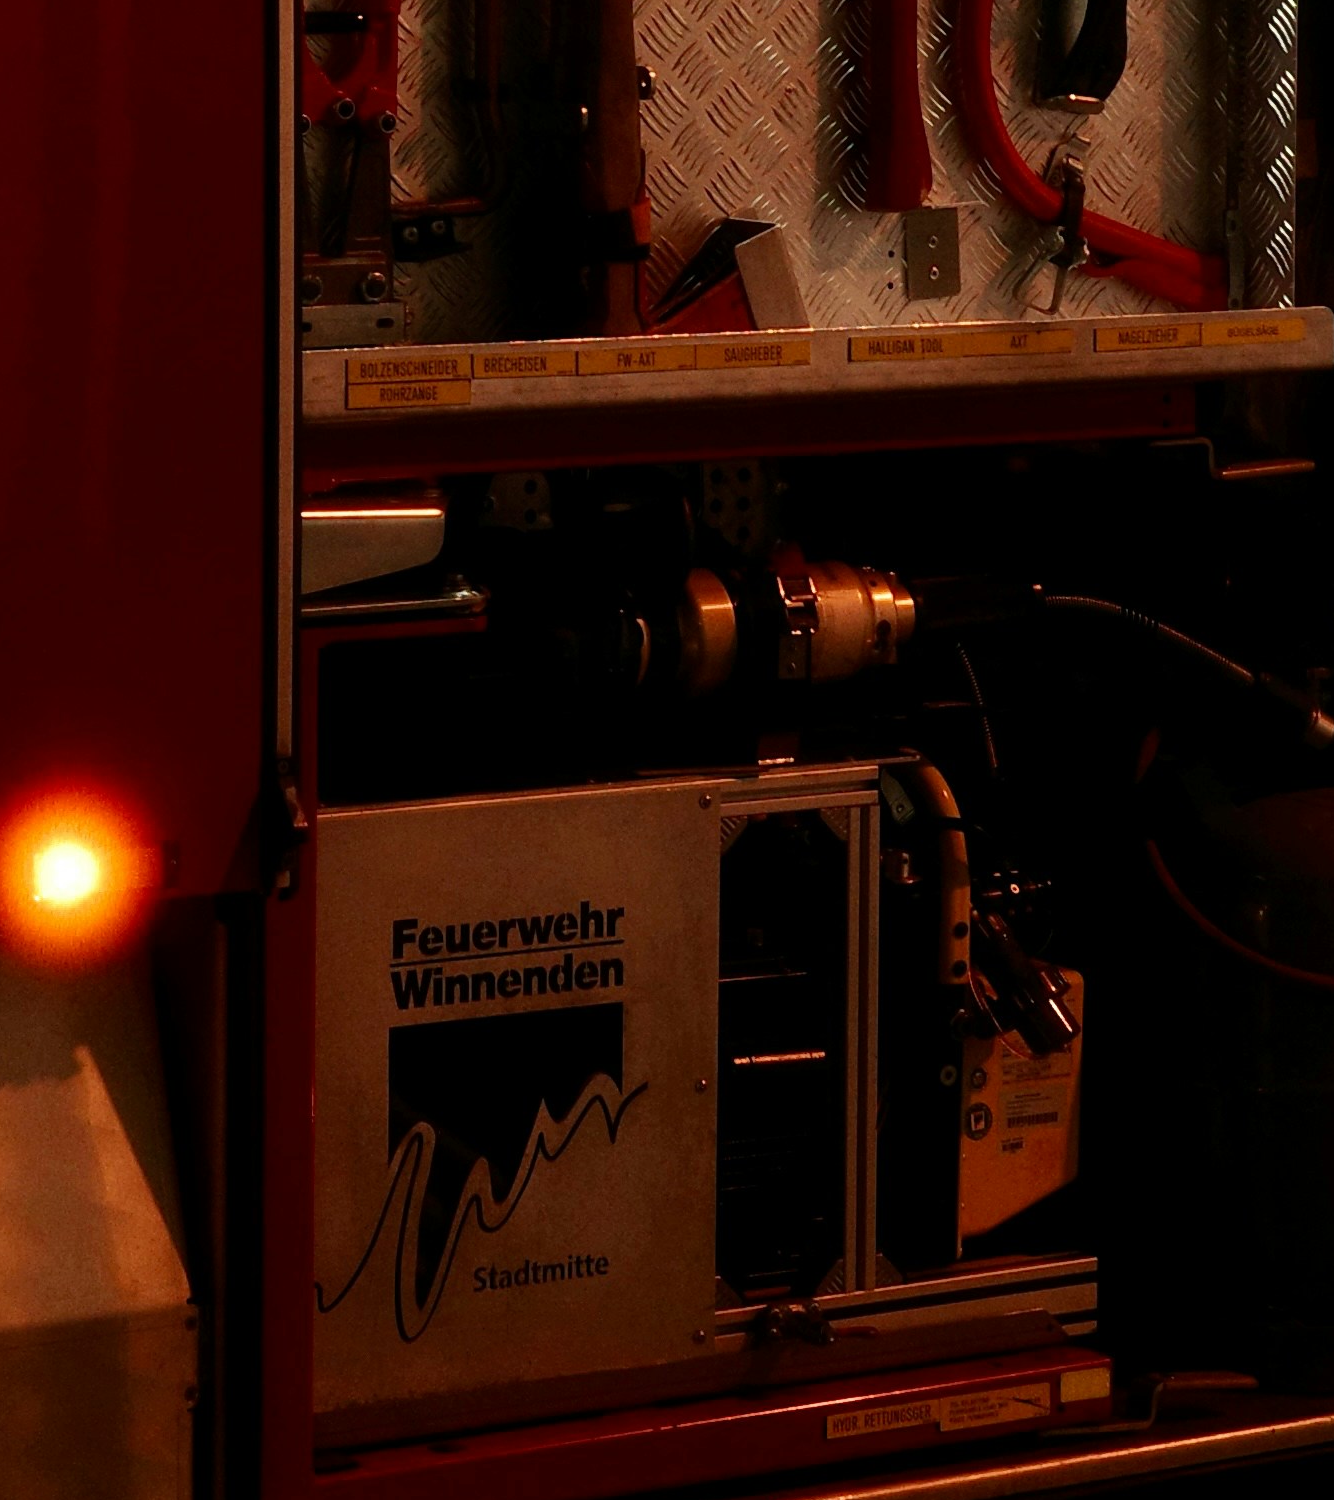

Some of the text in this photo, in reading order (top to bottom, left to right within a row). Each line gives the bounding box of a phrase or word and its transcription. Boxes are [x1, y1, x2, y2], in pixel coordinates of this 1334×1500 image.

[1009, 333, 1029, 349] AXT
[1118, 327, 1179, 345] NAGELZIEHER
[724, 345, 783, 363] SAUGHEBER
[868, 337, 944, 356] HALLIGAN TOOL
[483, 356, 547, 373] BRECHEISEN
[616, 351, 656, 367] FW-AXT
[360, 359, 458, 379] BOLZENSCHNEIDER
[379, 386, 438, 403] ROHRZANGE
[390, 899, 625, 959] Feuerwehr
[390, 953, 625, 1011] Winnenden
[472, 1252, 610, 1294] Stadtmitte
